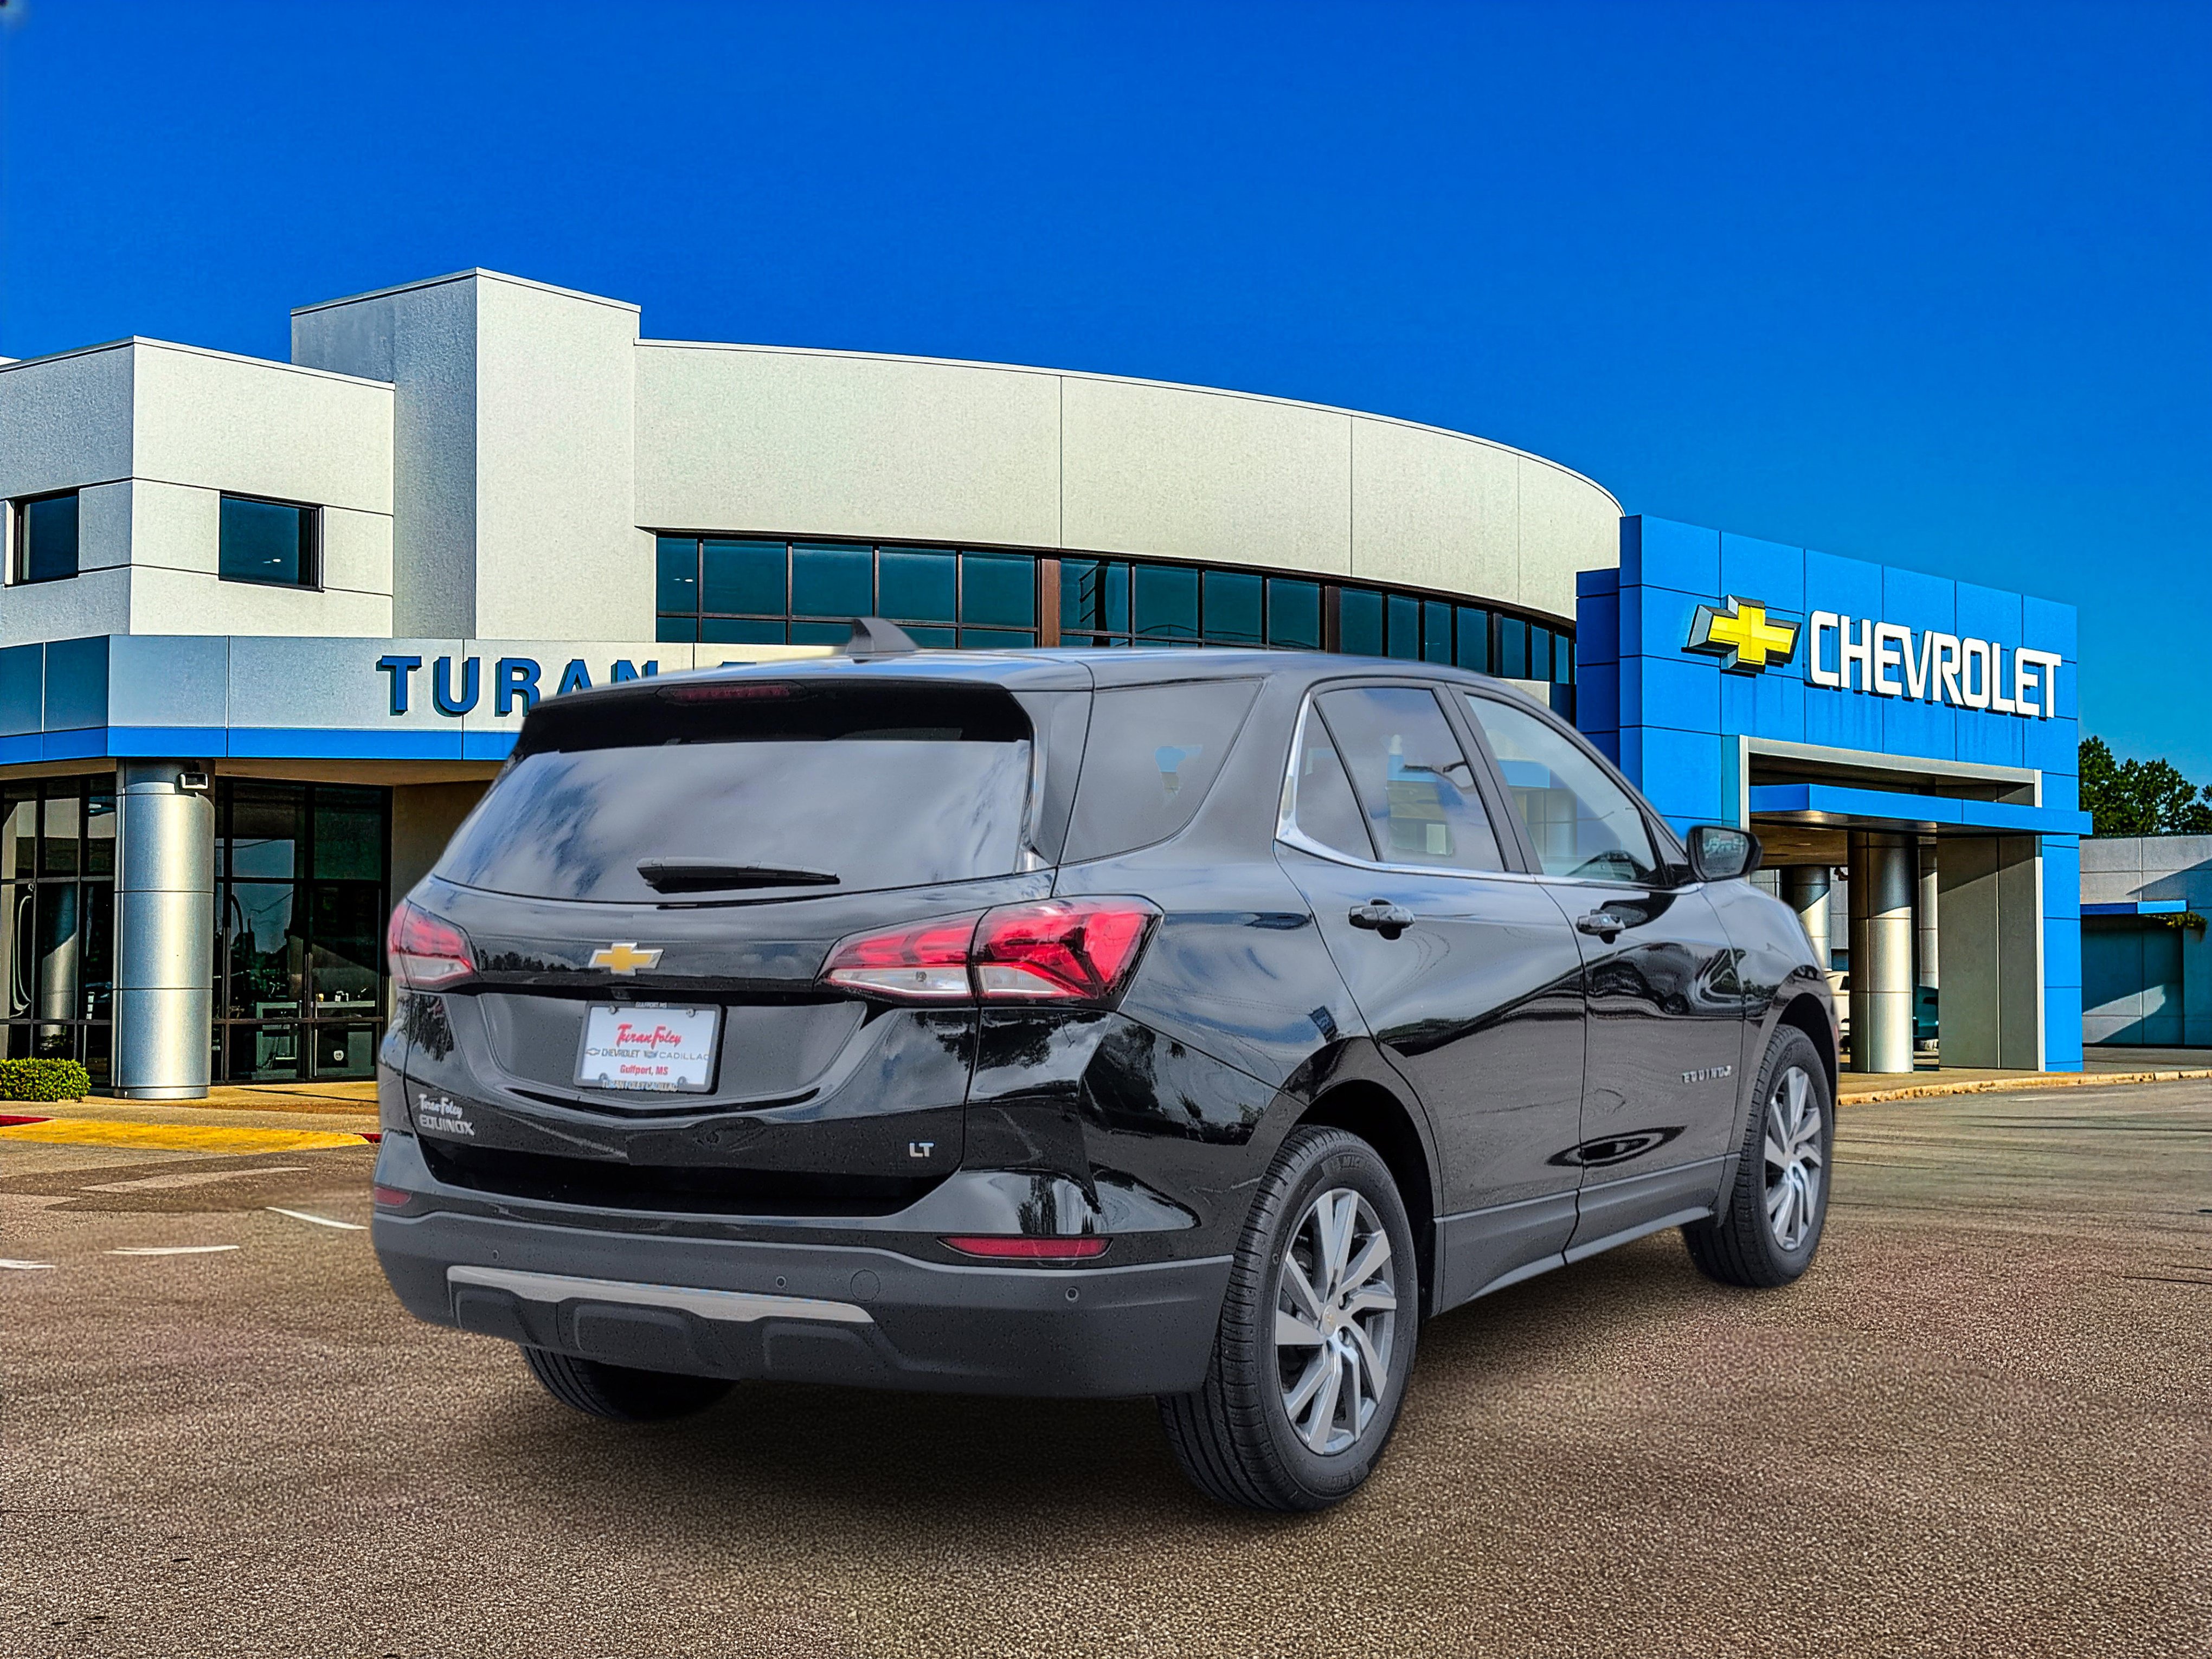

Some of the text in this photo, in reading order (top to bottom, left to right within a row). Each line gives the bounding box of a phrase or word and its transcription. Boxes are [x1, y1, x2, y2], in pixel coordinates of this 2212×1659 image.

[1810, 610, 2062, 718] CHEVROLET
[601, 1049, 709, 1061] CHEVROLET CADILLAC
[620, 1064, 668, 1076] Gulfport, MS
[419, 1114, 475, 1136] EQUINOX
[909, 1142, 934, 1158] LT
